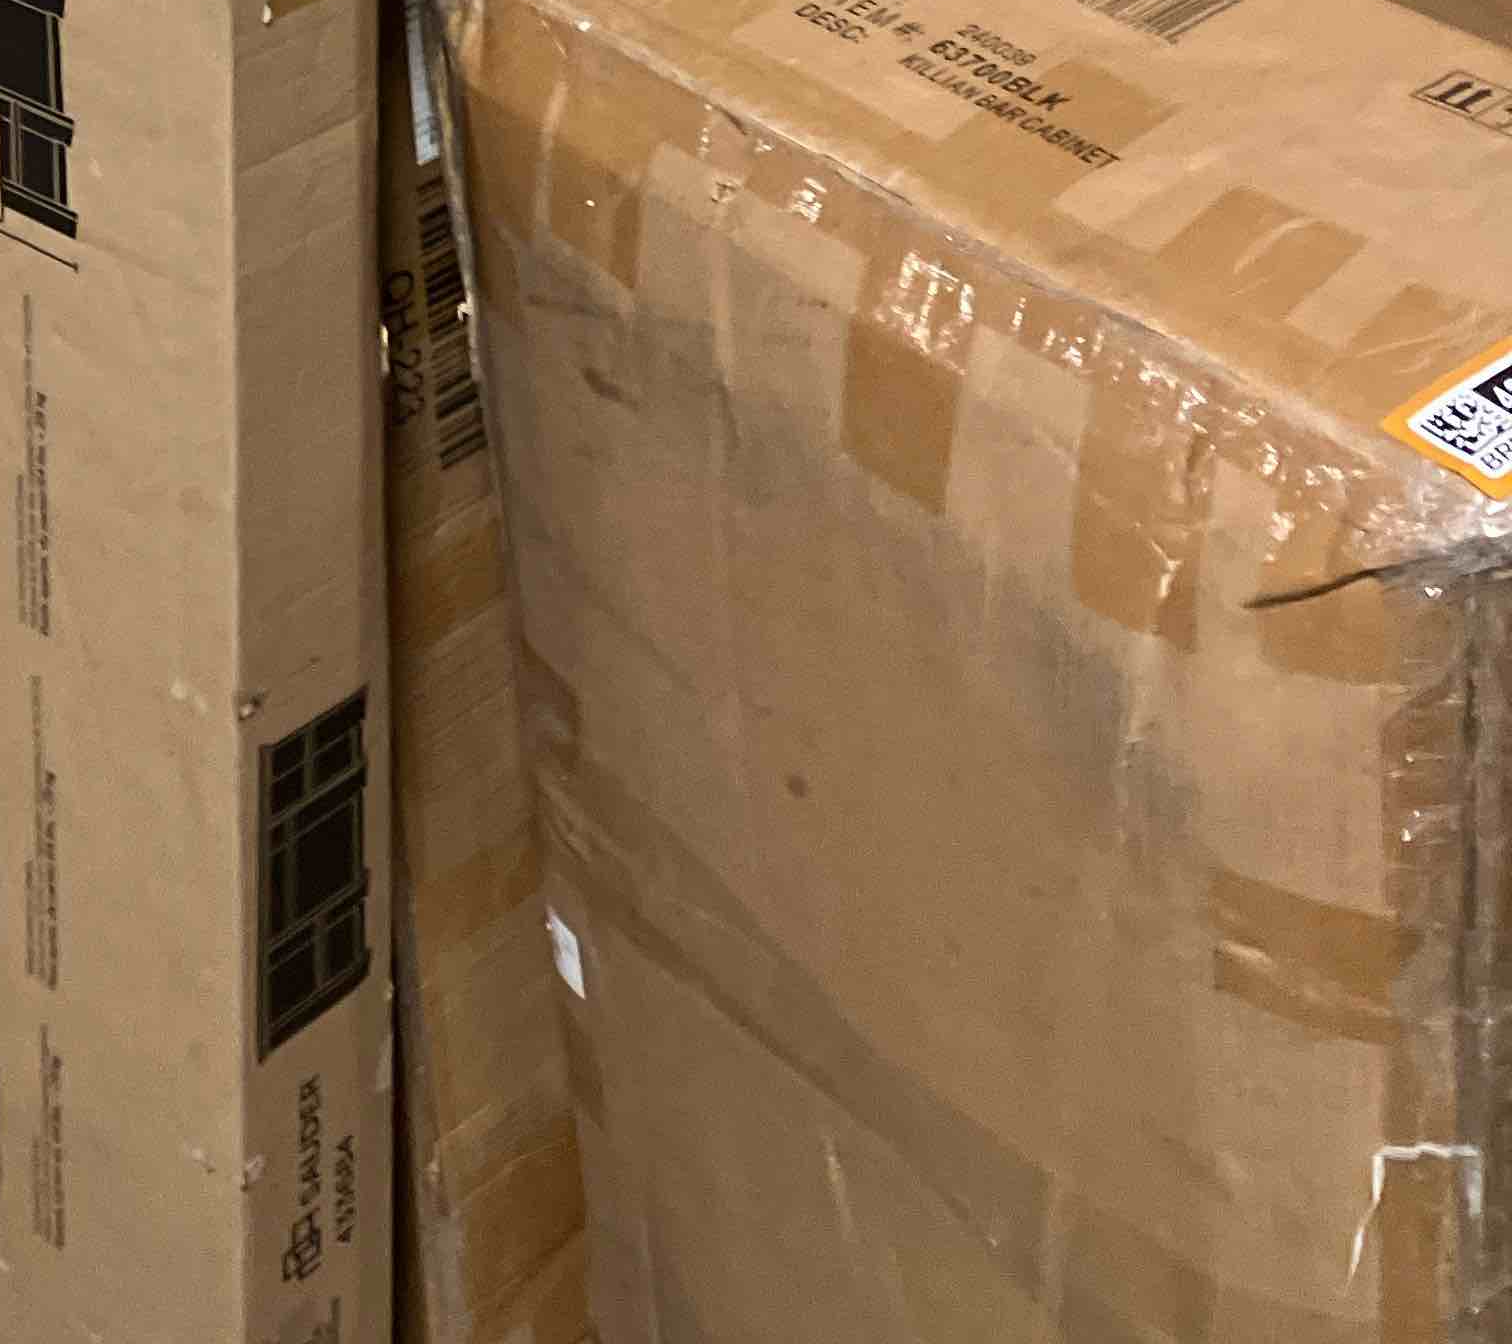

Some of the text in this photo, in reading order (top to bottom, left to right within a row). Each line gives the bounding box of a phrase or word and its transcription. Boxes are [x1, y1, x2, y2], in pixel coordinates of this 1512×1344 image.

[898, 51, 984, 102] KILLIAN
[974, 93, 1027, 124] BAR
[1019, 115, 1122, 170] CABINET
[929, 39, 1073, 112] 63700BLK
